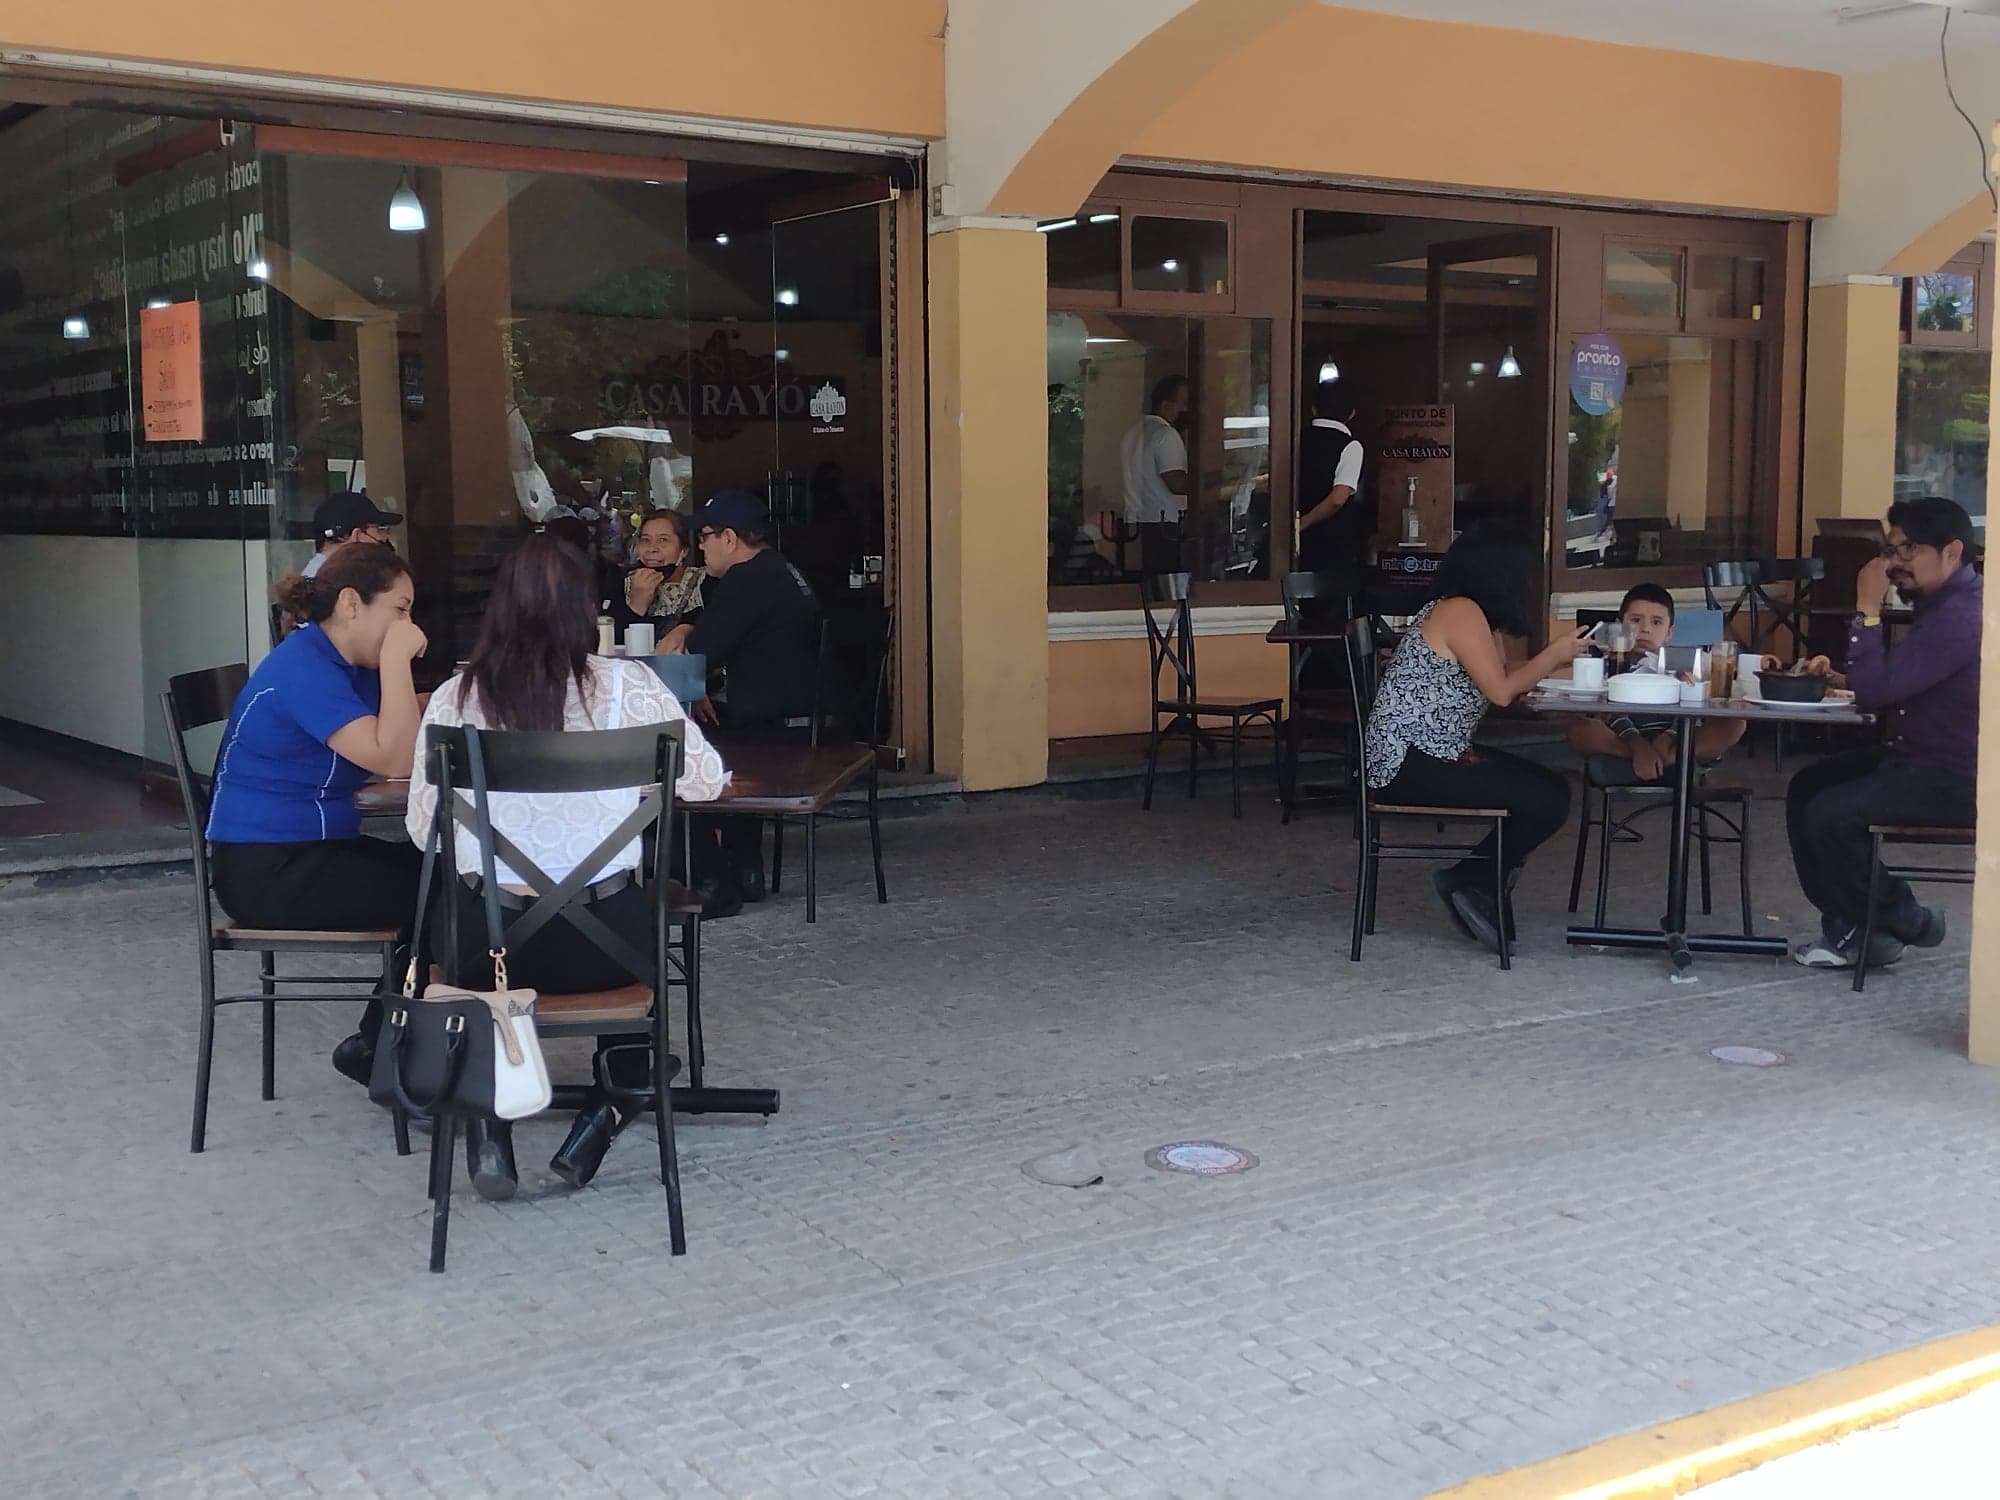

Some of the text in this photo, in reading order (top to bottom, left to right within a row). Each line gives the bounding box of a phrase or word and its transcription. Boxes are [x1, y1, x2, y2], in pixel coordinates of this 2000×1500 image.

[1577, 351, 1620, 368] pronto
[605, 376, 814, 416] CASA RAYÓ
[1430, 408, 1447, 418] DE
[1382, 446, 1410, 459] CASA
